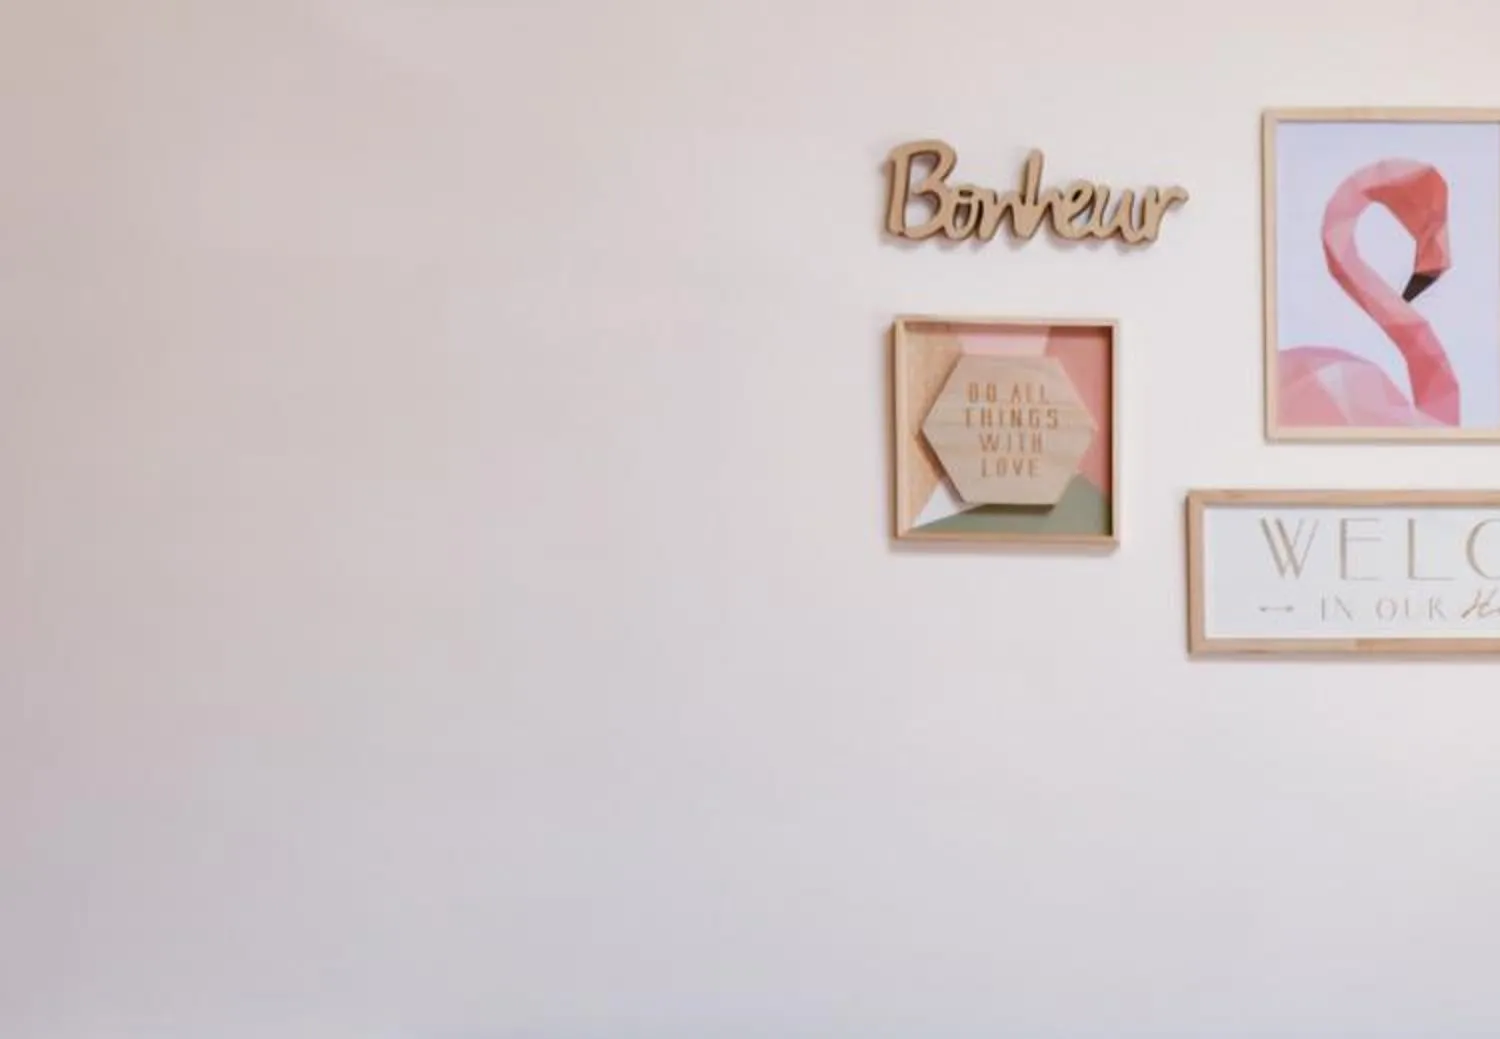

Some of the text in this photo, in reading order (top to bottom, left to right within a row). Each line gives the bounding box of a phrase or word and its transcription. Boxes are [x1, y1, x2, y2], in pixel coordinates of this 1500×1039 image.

[883, 139, 1189, 244] Bonheur
[968, 382, 1049, 404] DO ALL
[964, 407, 1059, 430] THINGS
[979, 433, 1043, 455] WITH
[981, 457, 1041, 479] LOVE
[1319, 594, 1354, 621] IN
[1375, 595, 1447, 621] OUR
